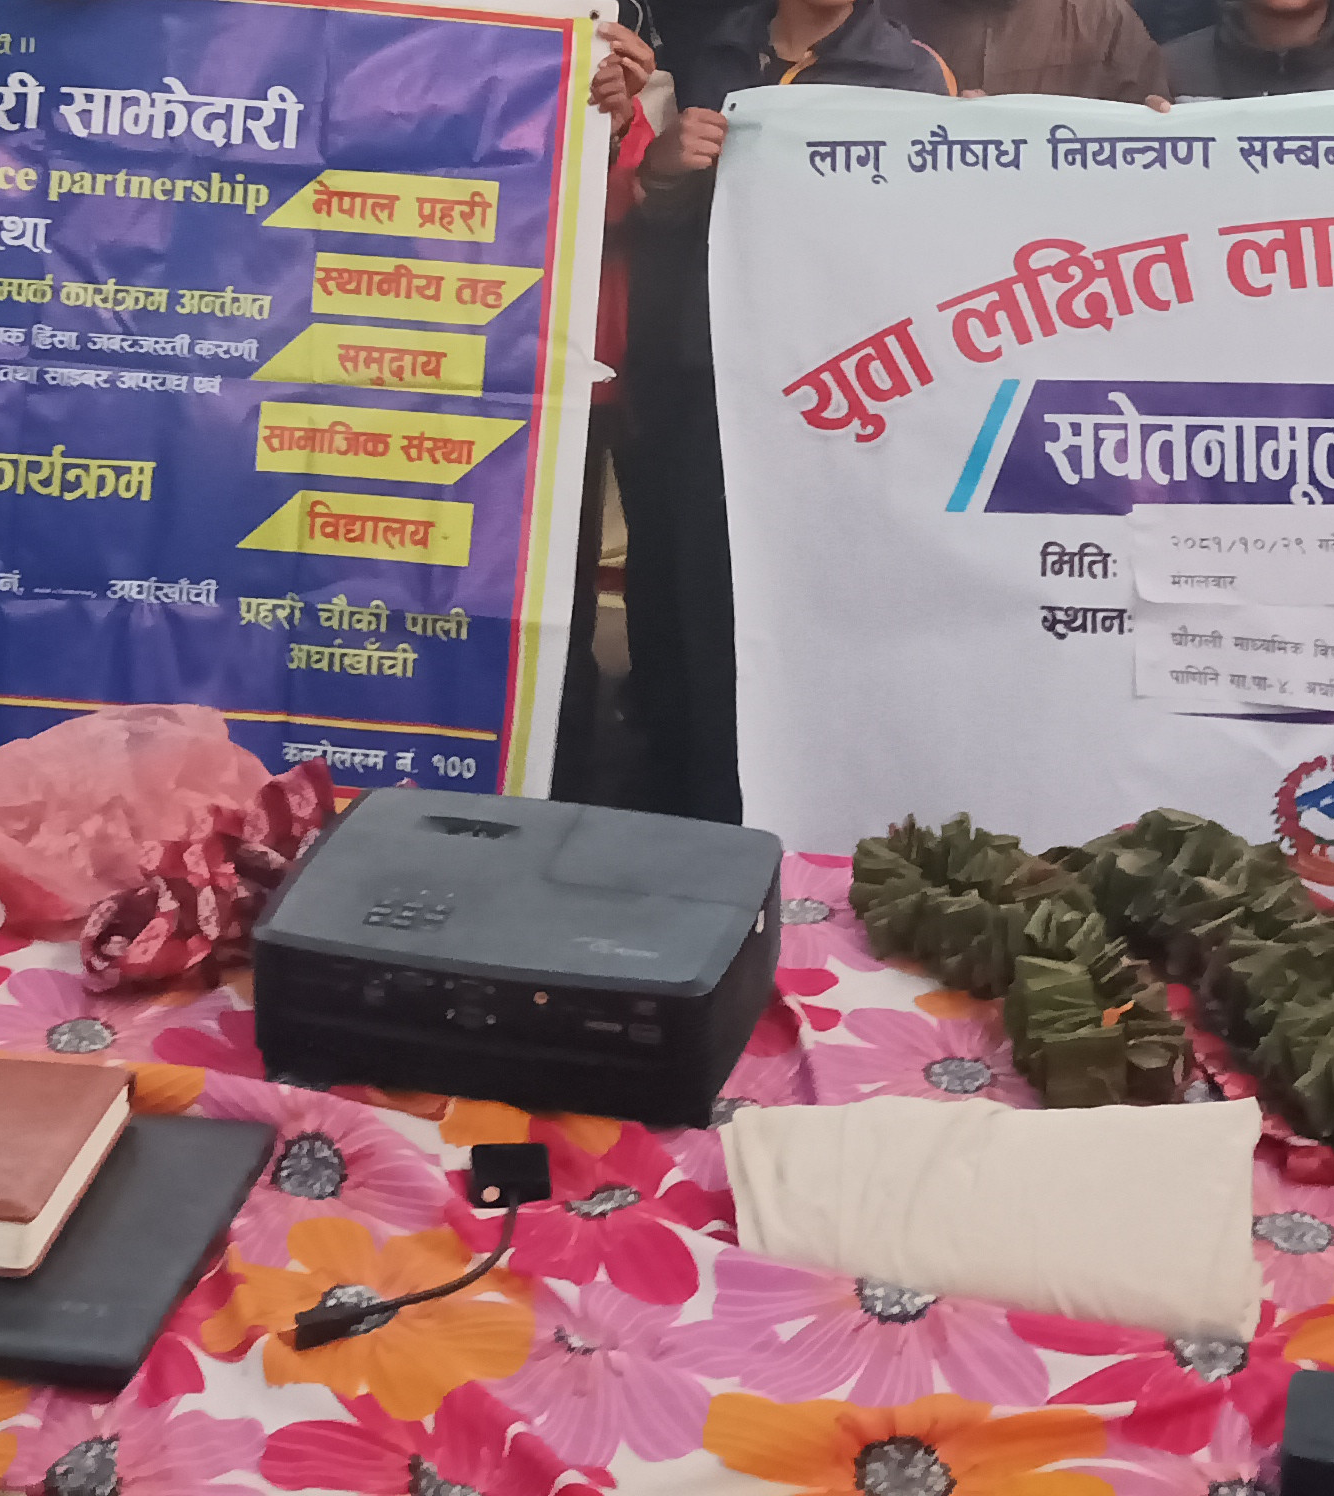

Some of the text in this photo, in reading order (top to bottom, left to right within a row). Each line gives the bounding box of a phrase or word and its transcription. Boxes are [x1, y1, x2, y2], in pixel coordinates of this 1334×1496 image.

[59, 76, 305, 151] साझेदारी
[806, 140, 887, 184] लागू
[907, 124, 1028, 173] औषध
[1046, 125, 1217, 172] नियन्त्रण
[48, 168, 270, 215] partnership
[312, 180, 493, 234] नेपाल प्रहरी
[60, 278, 170, 313] कार्यक्रम
[314, 264, 507, 309] स्थानीय तह
[782, 317, 935, 443] युवा
[936, 233, 1194, 364] लक्षित
[338, 344, 447, 386] समुदाय
[262, 420, 477, 466] सामाजिक संस्था
[307, 499, 437, 550] विद्यालय
[1170, 535, 1307, 554] २०८१/१०/२९
[238, 590, 470, 641] प्रहरी चौकी पाली
[431, 753, 477, 779] १००
